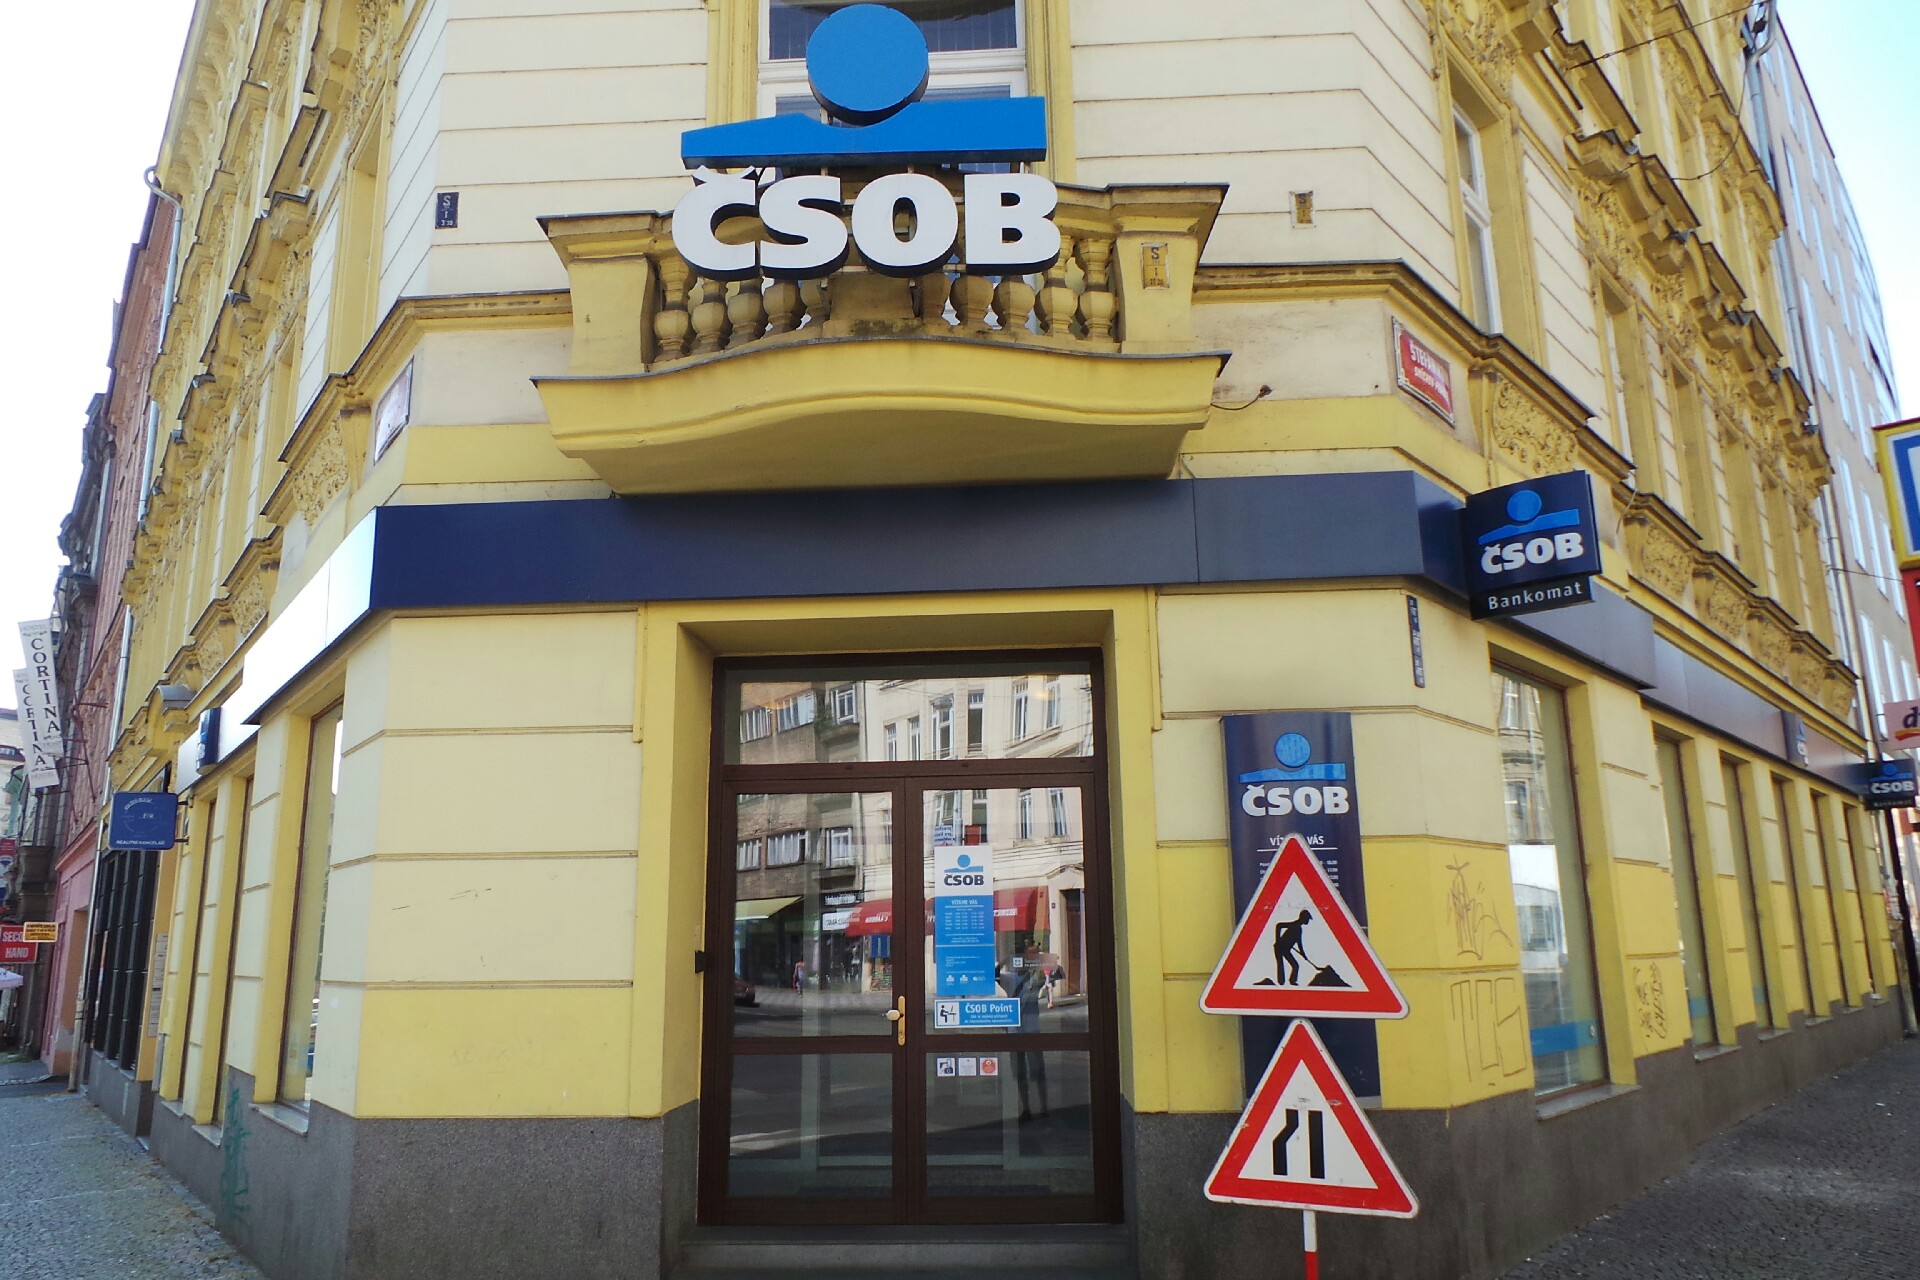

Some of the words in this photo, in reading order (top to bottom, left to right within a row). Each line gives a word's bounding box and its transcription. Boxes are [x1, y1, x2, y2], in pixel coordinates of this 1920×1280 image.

[672, 165, 1060, 276] ČSOB
[1481, 533, 1584, 574] ČSOB
[1488, 582, 1583, 610] Bankomat
[31, 638, 61, 733] CORTINA
[1241, 784, 1350, 817] ČSOB
[1306, 833, 1325, 845] VÁS
[943, 873, 984, 886] ČSOB
[2, 931, 23, 942] SECO
[5, 947, 29, 958] HAND
[965, 1002, 987, 1013] ČSOB
[989, 1002, 1013, 1013] Point
